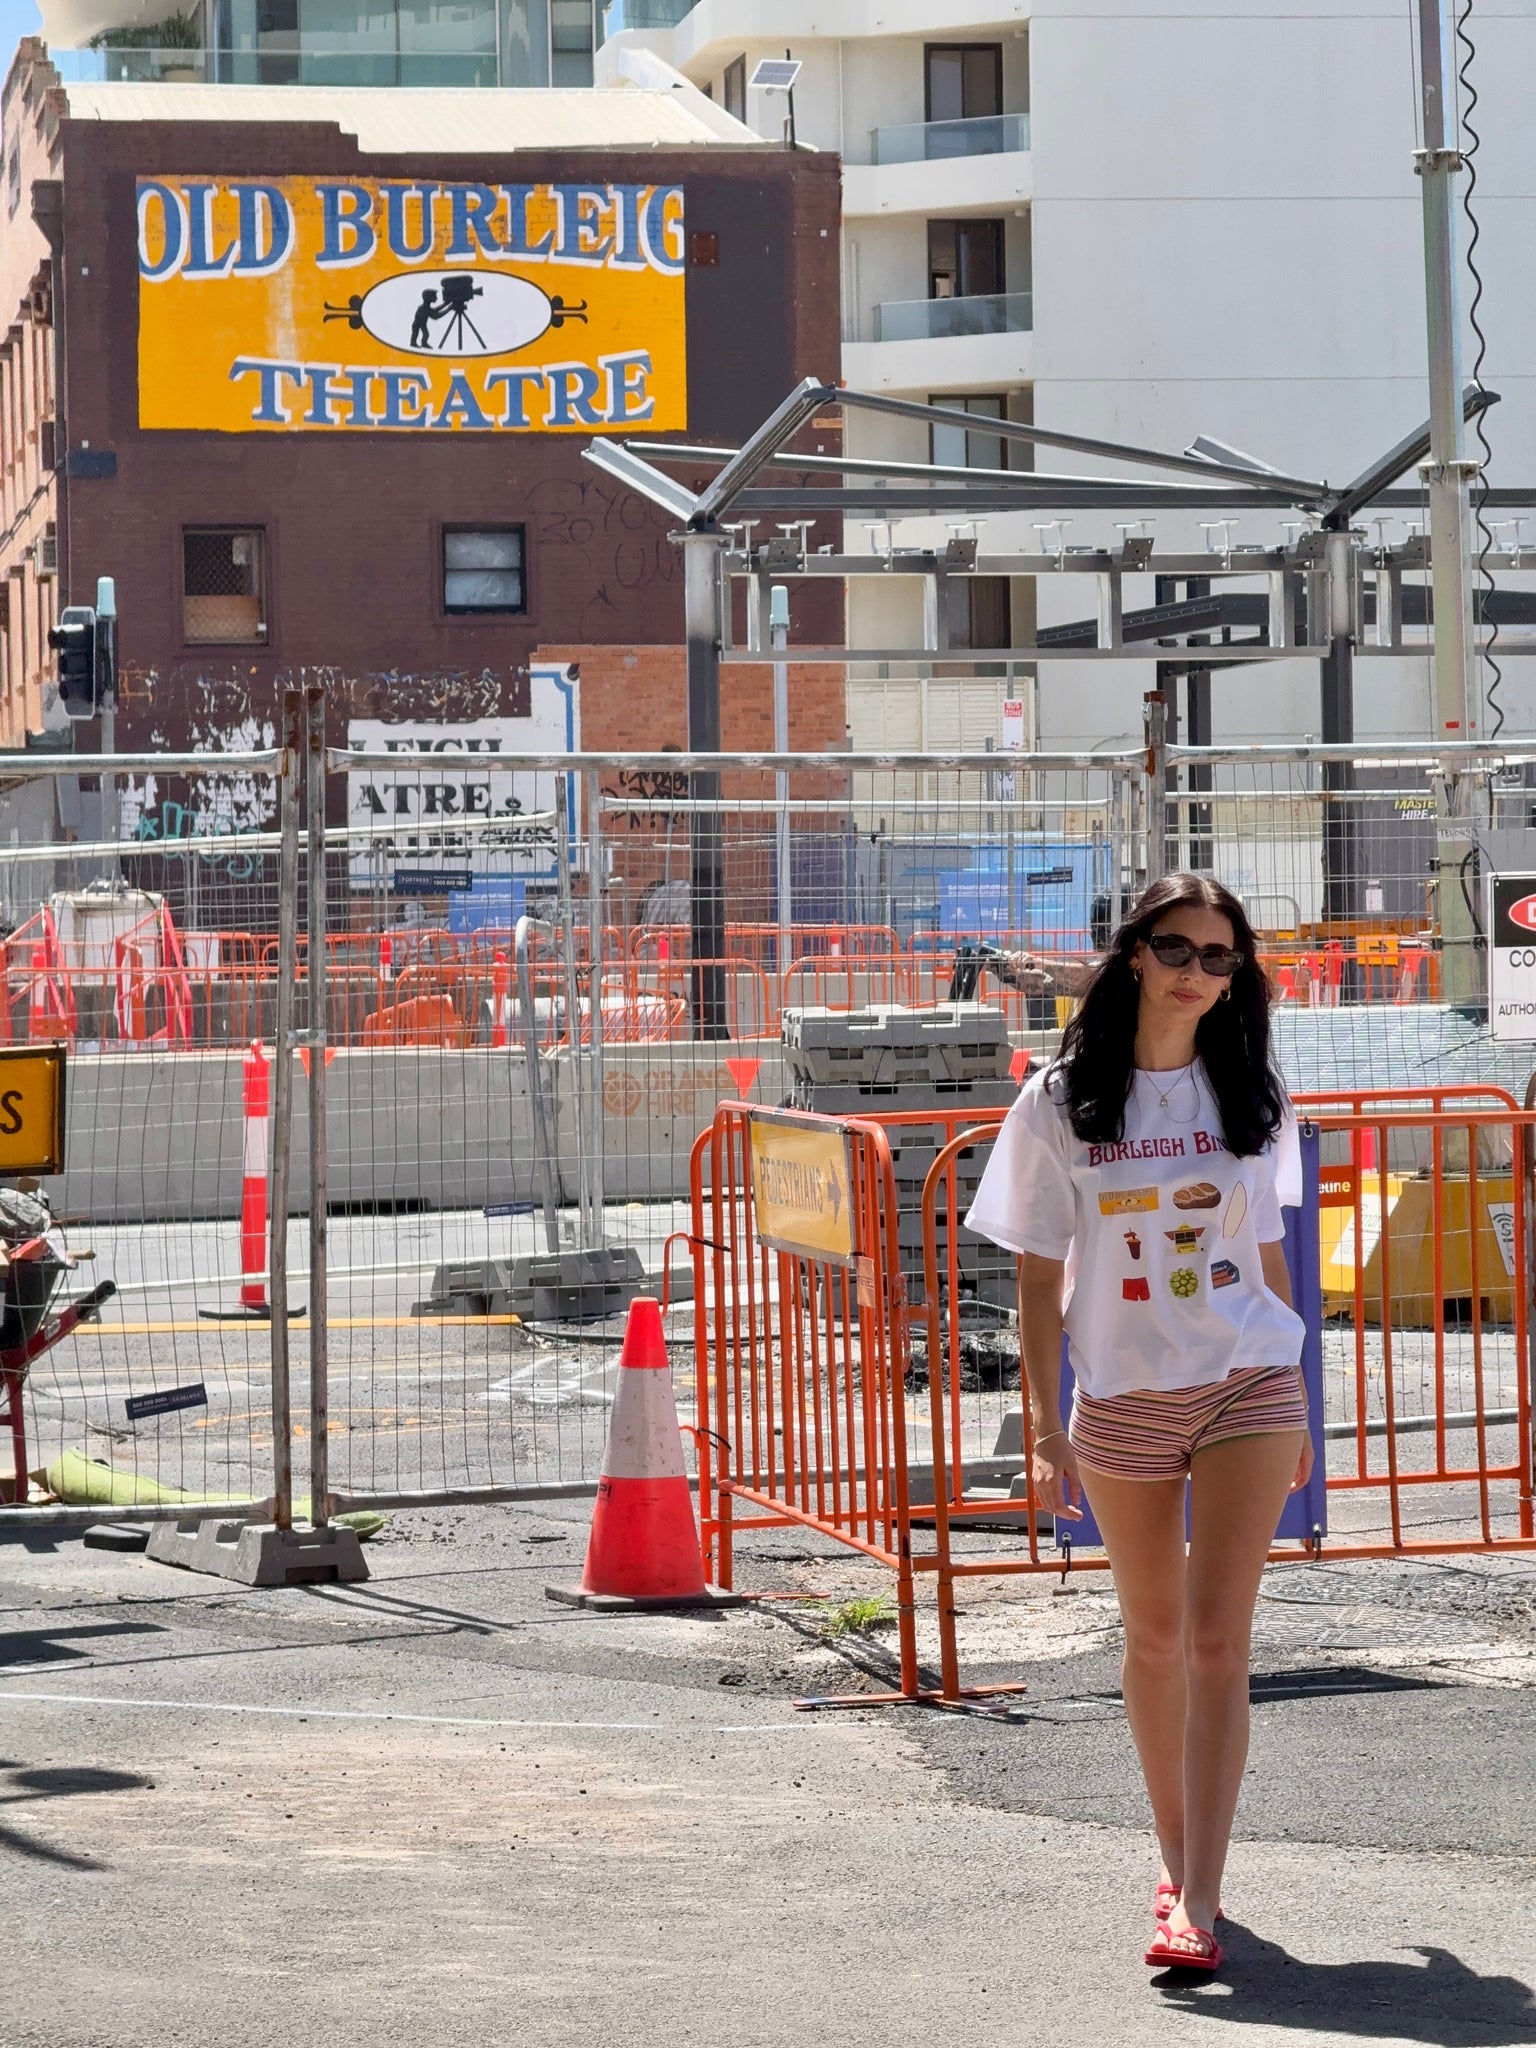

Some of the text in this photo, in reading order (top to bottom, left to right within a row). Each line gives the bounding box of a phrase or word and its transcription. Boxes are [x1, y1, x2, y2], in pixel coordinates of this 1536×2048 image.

[136, 182, 685, 282] OLD BURLEIG
[229, 349, 656, 429] THEATRE
[1401, 810, 1428, 819] HIRE
[1498, 1001, 1536, 1017] AUTHO
[1088, 1137, 1186, 1167] BURLEIGH
[759, 1155, 824, 1214] PEDESTRIANS
